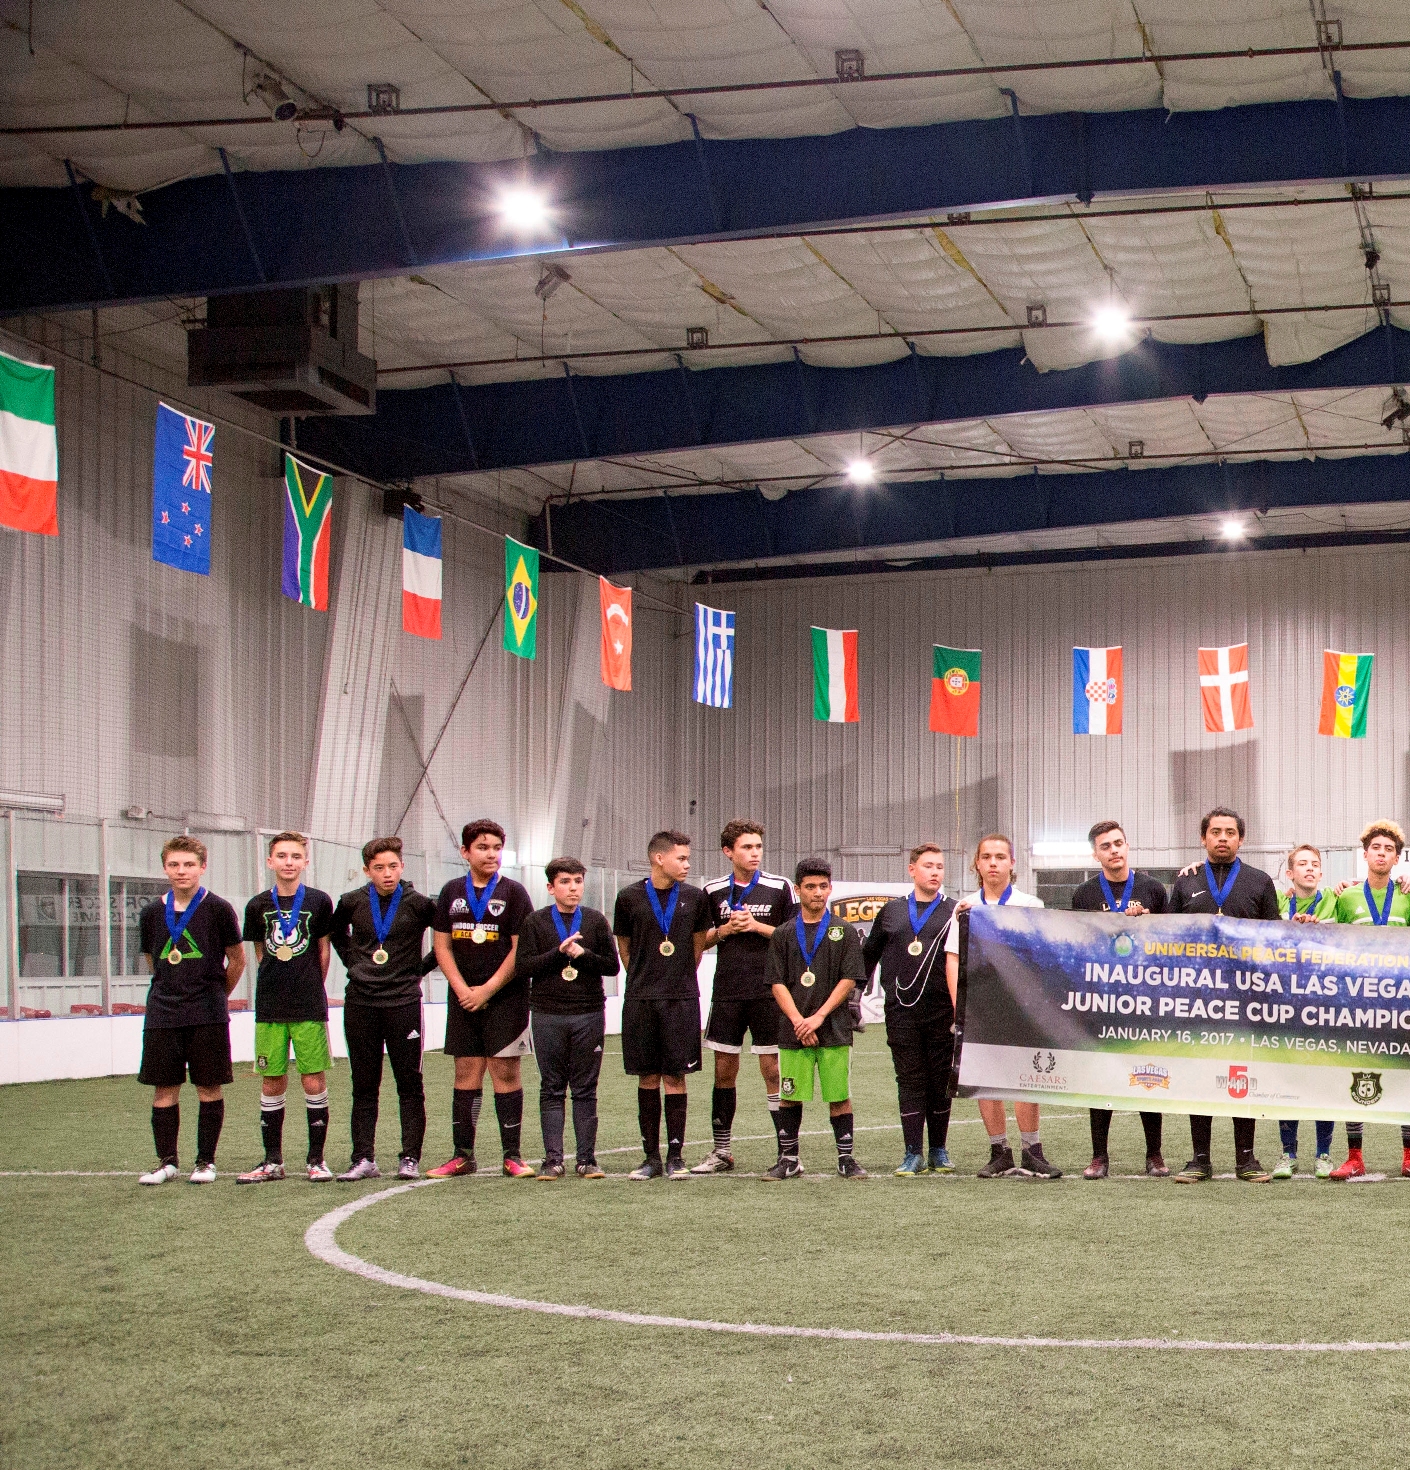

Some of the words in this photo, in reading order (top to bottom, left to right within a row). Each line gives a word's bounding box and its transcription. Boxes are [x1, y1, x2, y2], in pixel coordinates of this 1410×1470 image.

[1144, 941, 1237, 959] UNIVERSAL
[1240, 946, 1297, 963] PEACE
[1300, 949, 1410, 968] FEDERATION
[1085, 962, 1229, 989] INAUGURAL
[1235, 969, 1284, 994] USA
[1290, 974, 1339, 996] LAS
[1061, 991, 1151, 1016] JUNIOR
[1159, 997, 1240, 1021] PEACE
[1246, 1001, 1295, 1024] CUP
[1098, 1026, 1172, 1042] JANUARY
[1175, 1030, 1195, 1046] 16,
[1200, 1032, 1234, 1046] 2017
[1251, 1034, 1280, 1049] LAS
[1284, 1037, 1342, 1054] VEGAS,
[1019, 1073, 1067, 1084] CAESARS
[1227, 1065, 1248, 1099] 5
